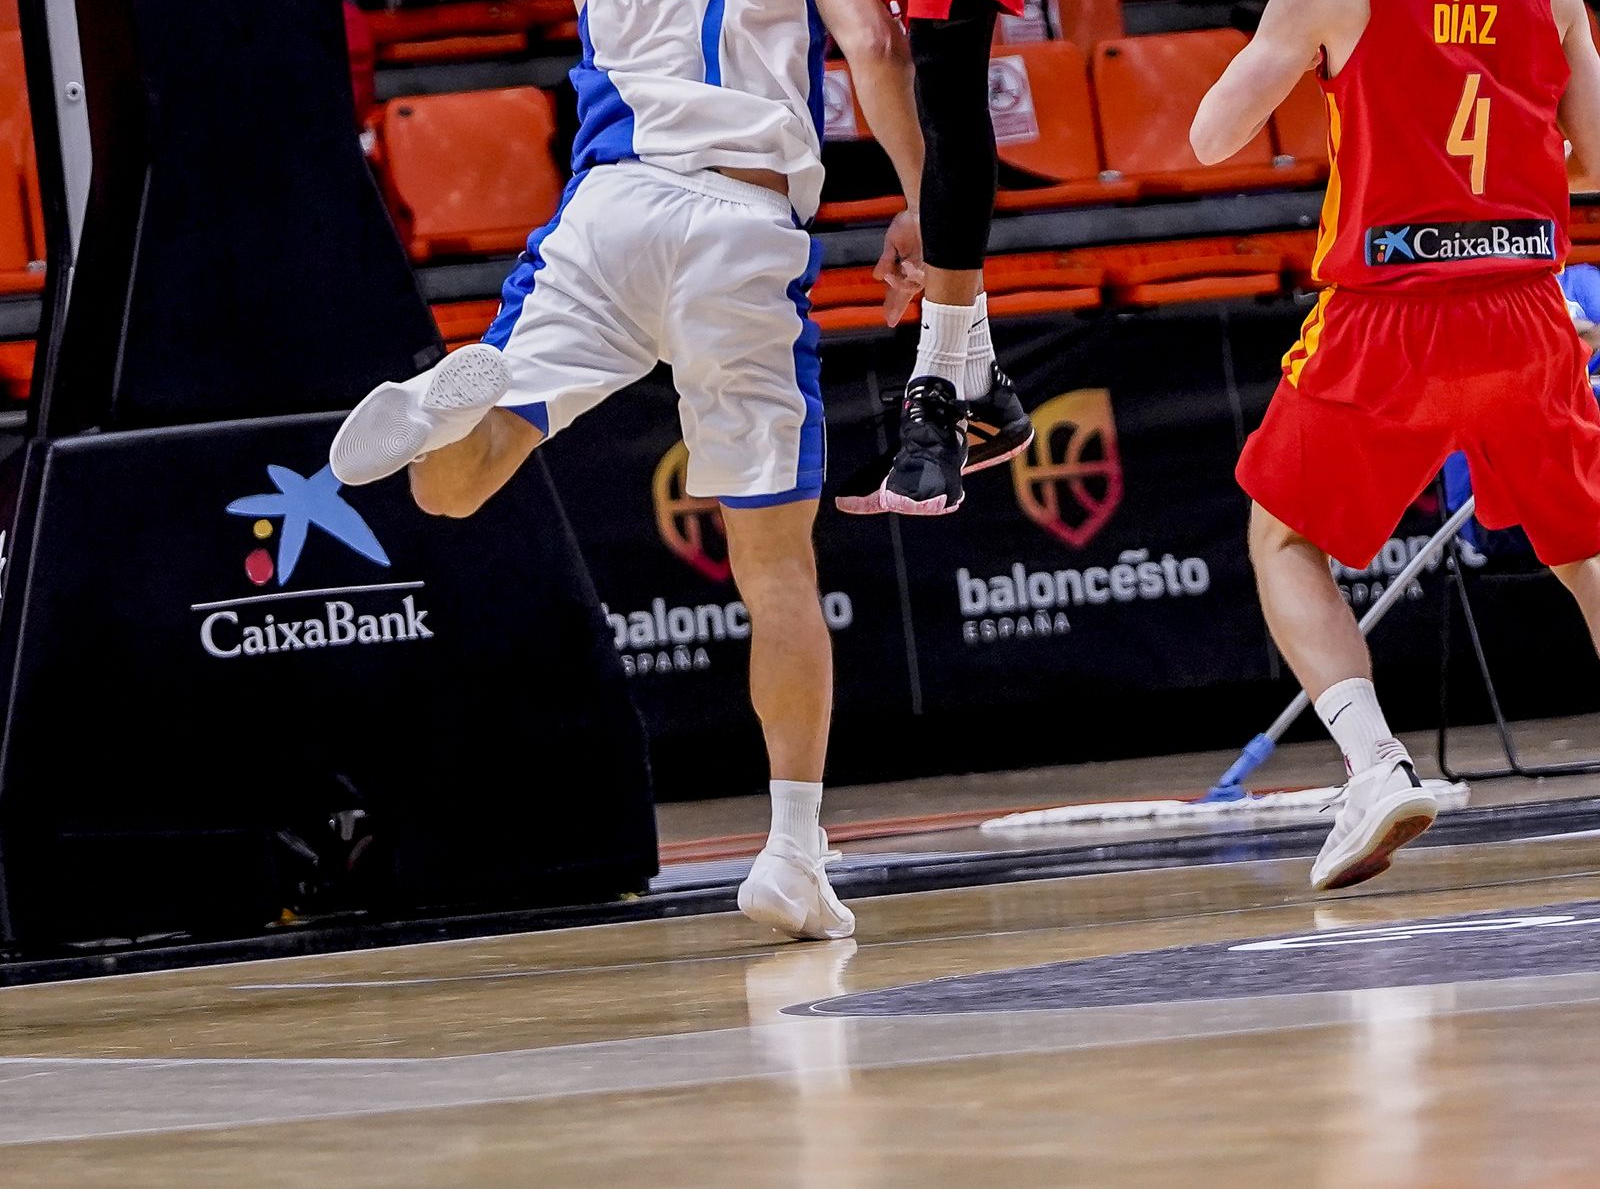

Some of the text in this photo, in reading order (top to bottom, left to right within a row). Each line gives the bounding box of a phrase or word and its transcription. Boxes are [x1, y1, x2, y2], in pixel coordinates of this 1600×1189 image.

[1446, 73, 1491, 195] 4
[1413, 225, 1551, 259] CaixaBank
[200, 594, 435, 659] CaixaBank
[600, 590, 854, 651] balonco
[962, 609, 1072, 646] ESPAÑA
[619, 644, 712, 679] SPAÑA
